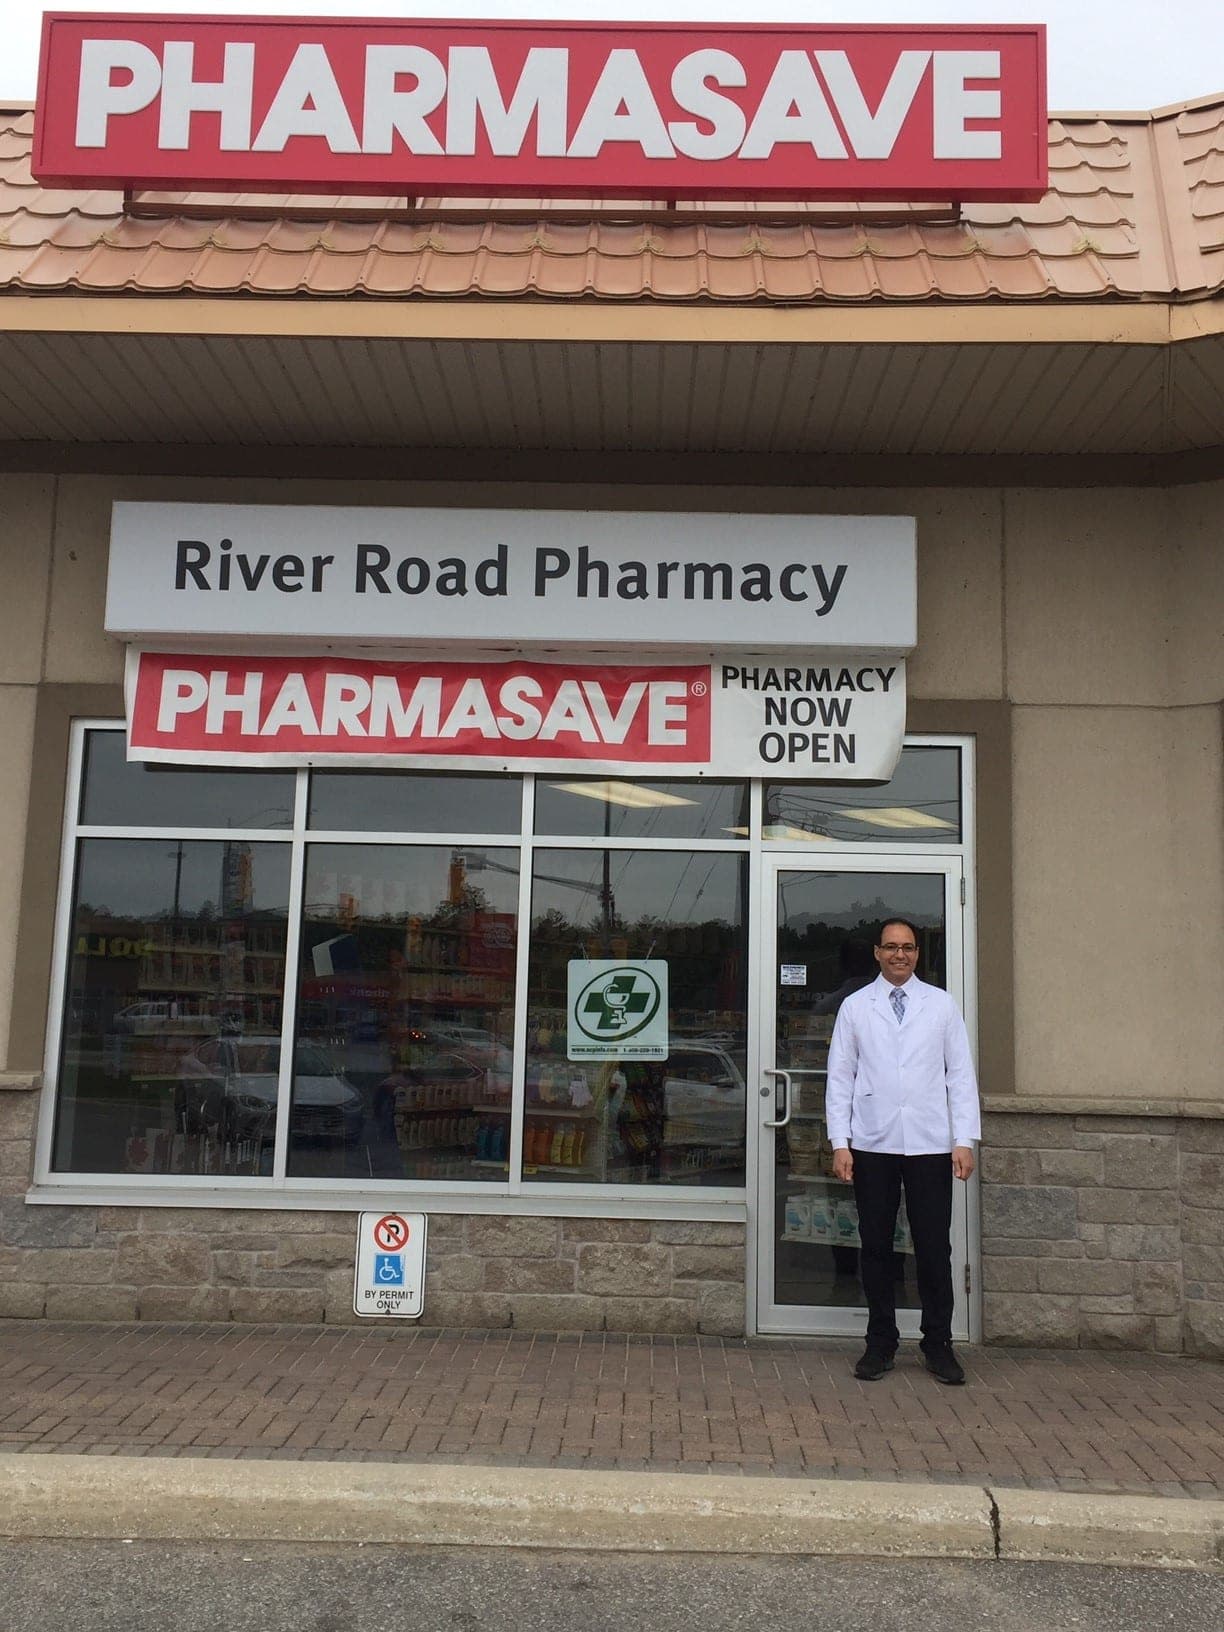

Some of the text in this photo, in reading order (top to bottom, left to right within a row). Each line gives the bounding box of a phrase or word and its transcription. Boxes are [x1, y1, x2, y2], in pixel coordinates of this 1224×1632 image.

[75, 39, 1002, 161] PHARMASAVE
[174, 538, 849, 617] River Road Pharmacy
[722, 665, 896, 692] PHARMACY
[765, 697, 852, 727] NOW
[759, 732, 856, 763] OPEN
[364, 1290, 414, 1300] BY PERMIT
[376, 1300, 401, 1310] ONLY
